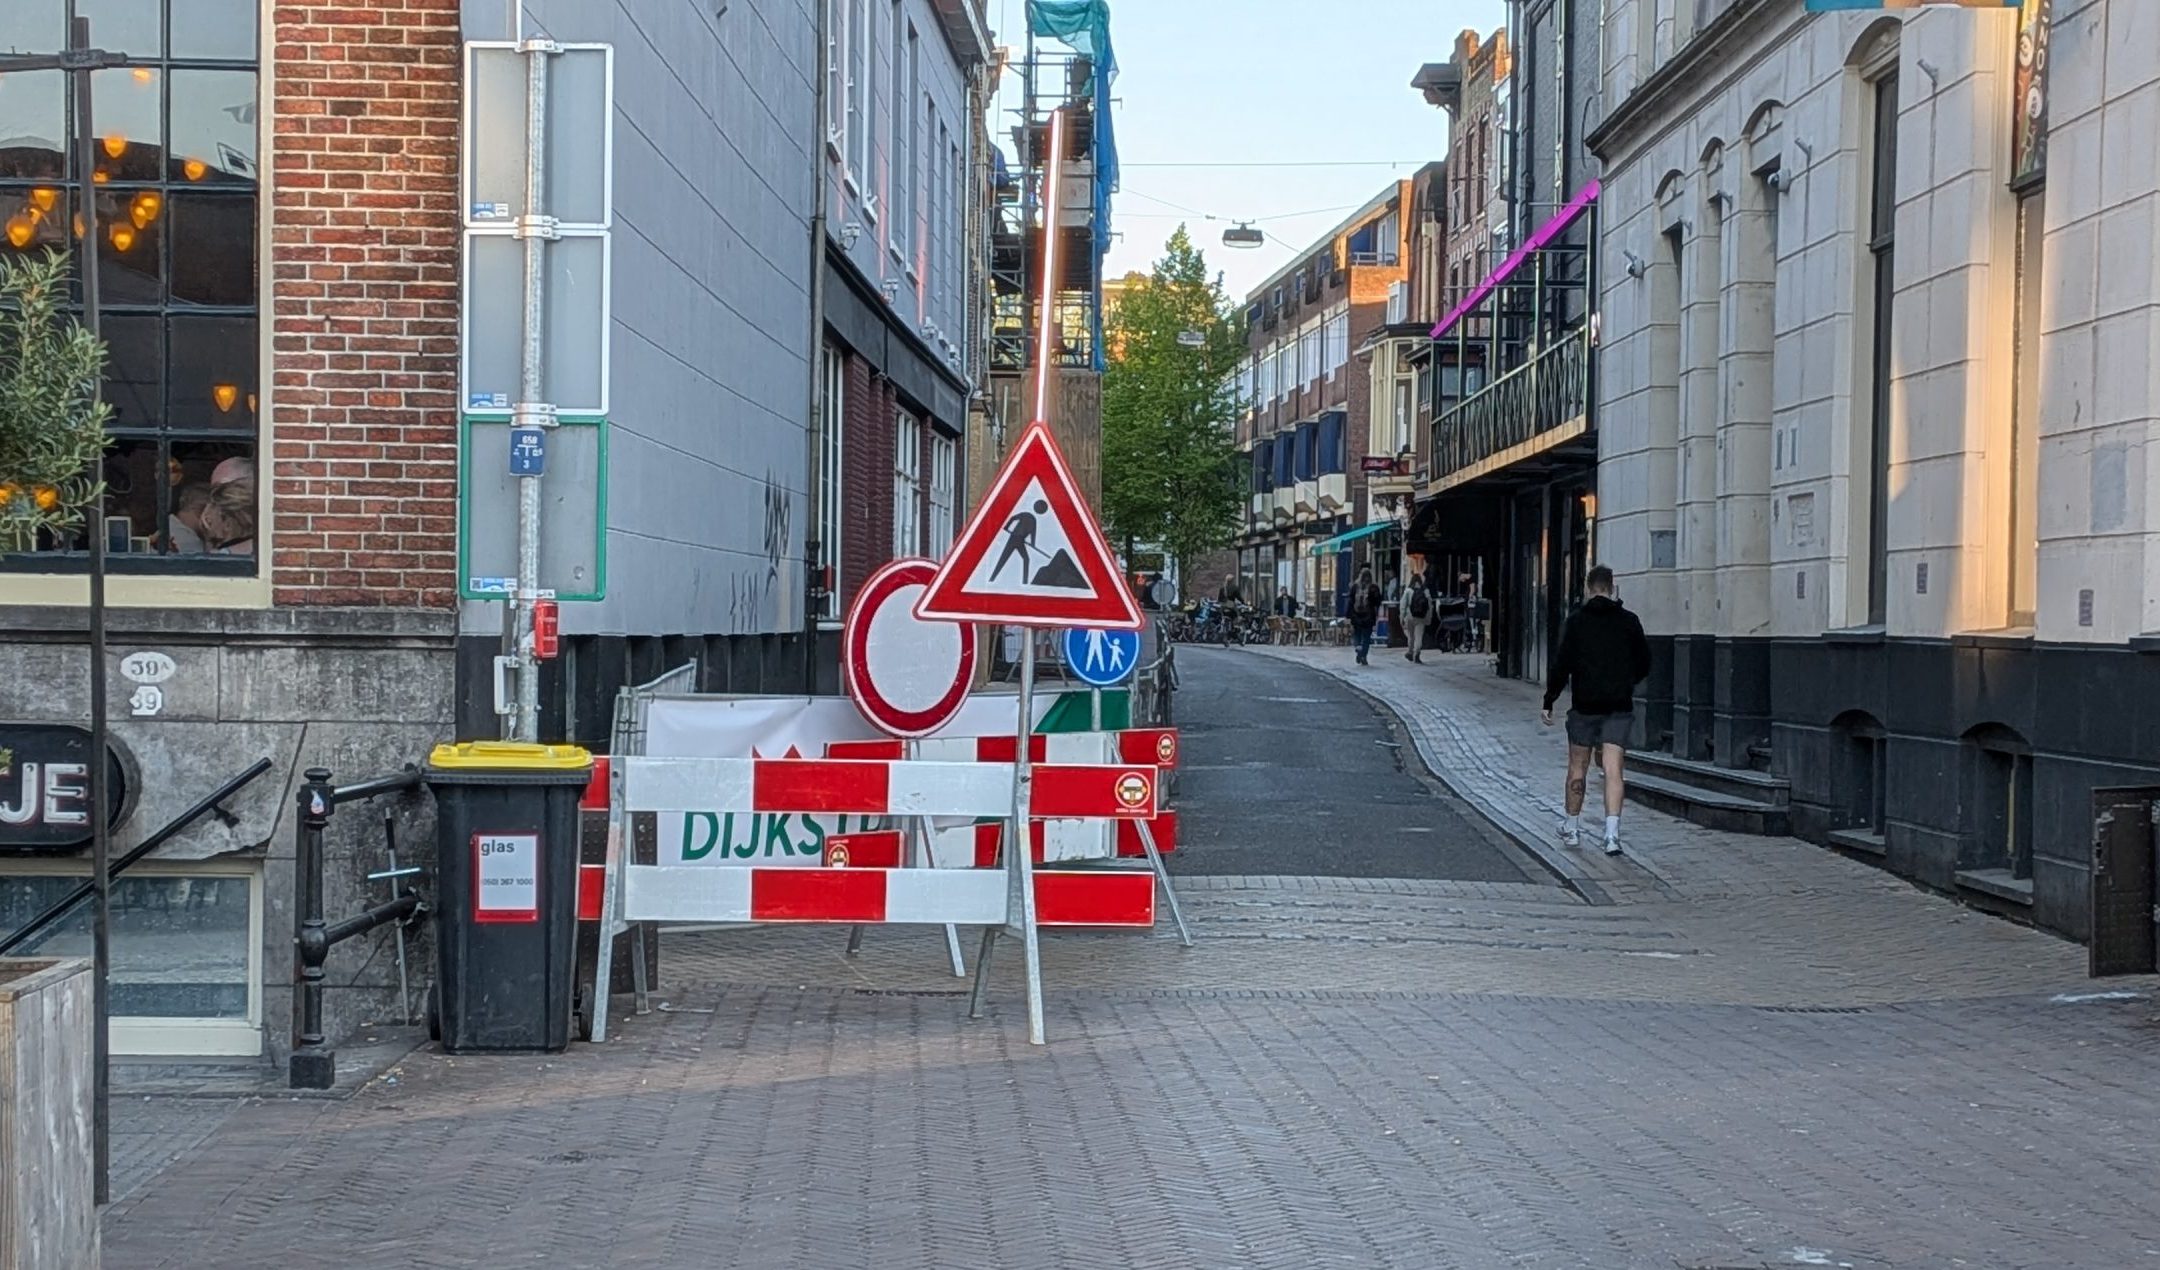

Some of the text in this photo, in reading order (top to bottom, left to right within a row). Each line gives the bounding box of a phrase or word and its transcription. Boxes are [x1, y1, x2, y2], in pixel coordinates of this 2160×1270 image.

[133, 692, 157, 710] 39
[0, 763, 87, 823] JE
[481, 839, 515, 856] glas
